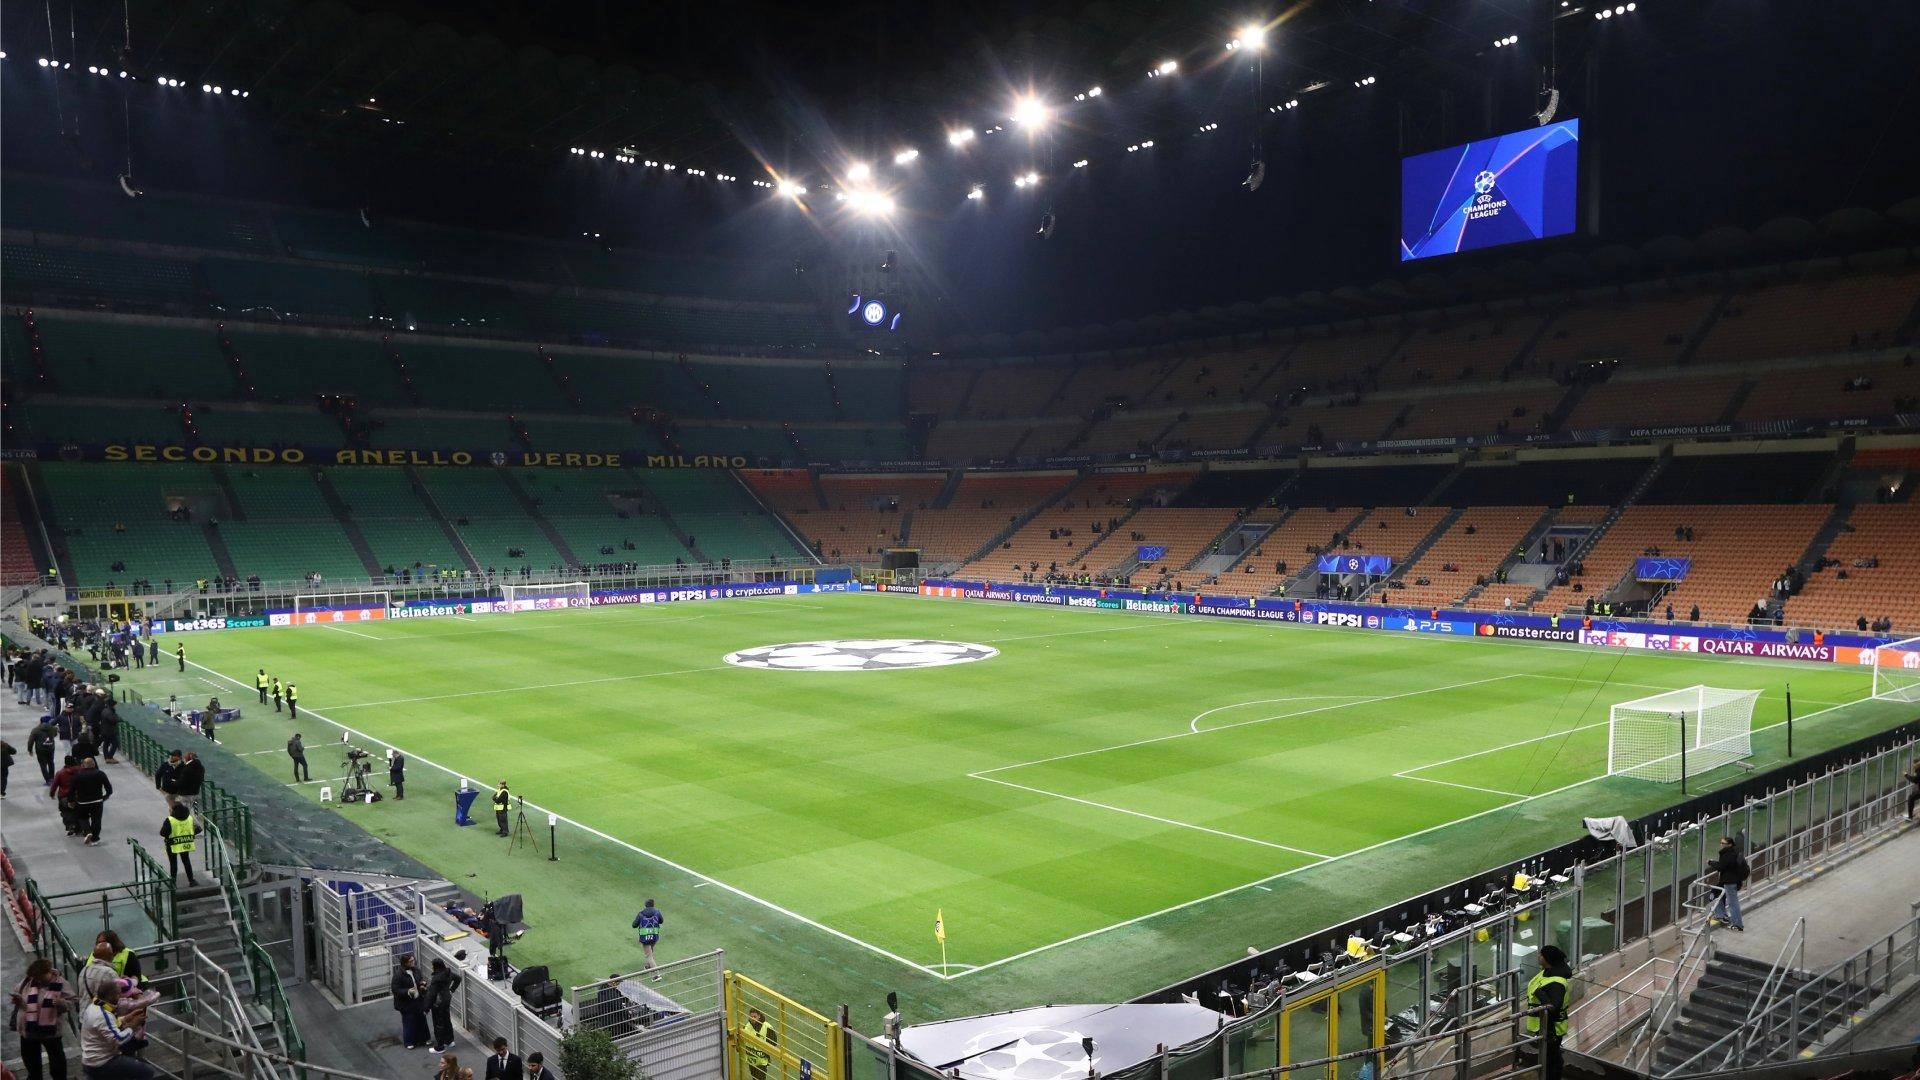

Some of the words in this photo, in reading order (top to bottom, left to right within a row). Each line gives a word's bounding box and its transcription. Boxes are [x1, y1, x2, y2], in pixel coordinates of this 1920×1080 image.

[1463, 200, 1507, 214] CHAMPIONS
[1470, 209, 1499, 220] LEAGUE
[1630, 429, 1650, 437] UEFA
[1652, 427, 1698, 436] CHAMPIONS
[1700, 425, 1732, 433] LEAGUE
[104, 445, 305, 463] SECONDO
[336, 449, 472, 465] ANELLO
[523, 452, 621, 467] VERDE
[647, 455, 746, 468] MILANO
[735, 586, 781, 597] crypto.com
[888, 585, 917, 593] mastercard
[965, 589, 984, 598] QATAR
[986, 590, 1010, 600] AIRWAYS
[571, 597, 600, 607] QATAR
[602, 595, 638, 604] AIRWAYS
[670, 590, 707, 602] PEPSI
[1022, 593, 1061, 604] crypto.com
[1068, 596, 1097, 607] bet365
[1097, 599, 1119, 609] Scores
[492, 601, 522, 612] FedEx
[535, 599, 563, 609] FedEx
[1126, 600, 1171, 613] Heineken
[391, 604, 453, 618] Heineken
[1198, 605, 1215, 614] UEFA
[1217, 607, 1255, 618] CHAMPIONS
[1258, 610, 1284, 619] LEAGUE
[174, 618, 225, 631] bet365
[226, 618, 265, 628] Scores
[1317, 611, 1362, 628] PEPSI
[1420, 621, 1453, 632] PS5
[1497, 625, 1574, 641] mastercard
[1584, 630, 1627, 646] FedEx
[1645, 634, 1691, 651] FedEx
[1703, 639, 1754, 655] QATAR
[1760, 643, 1829, 660] AIRWAYS
